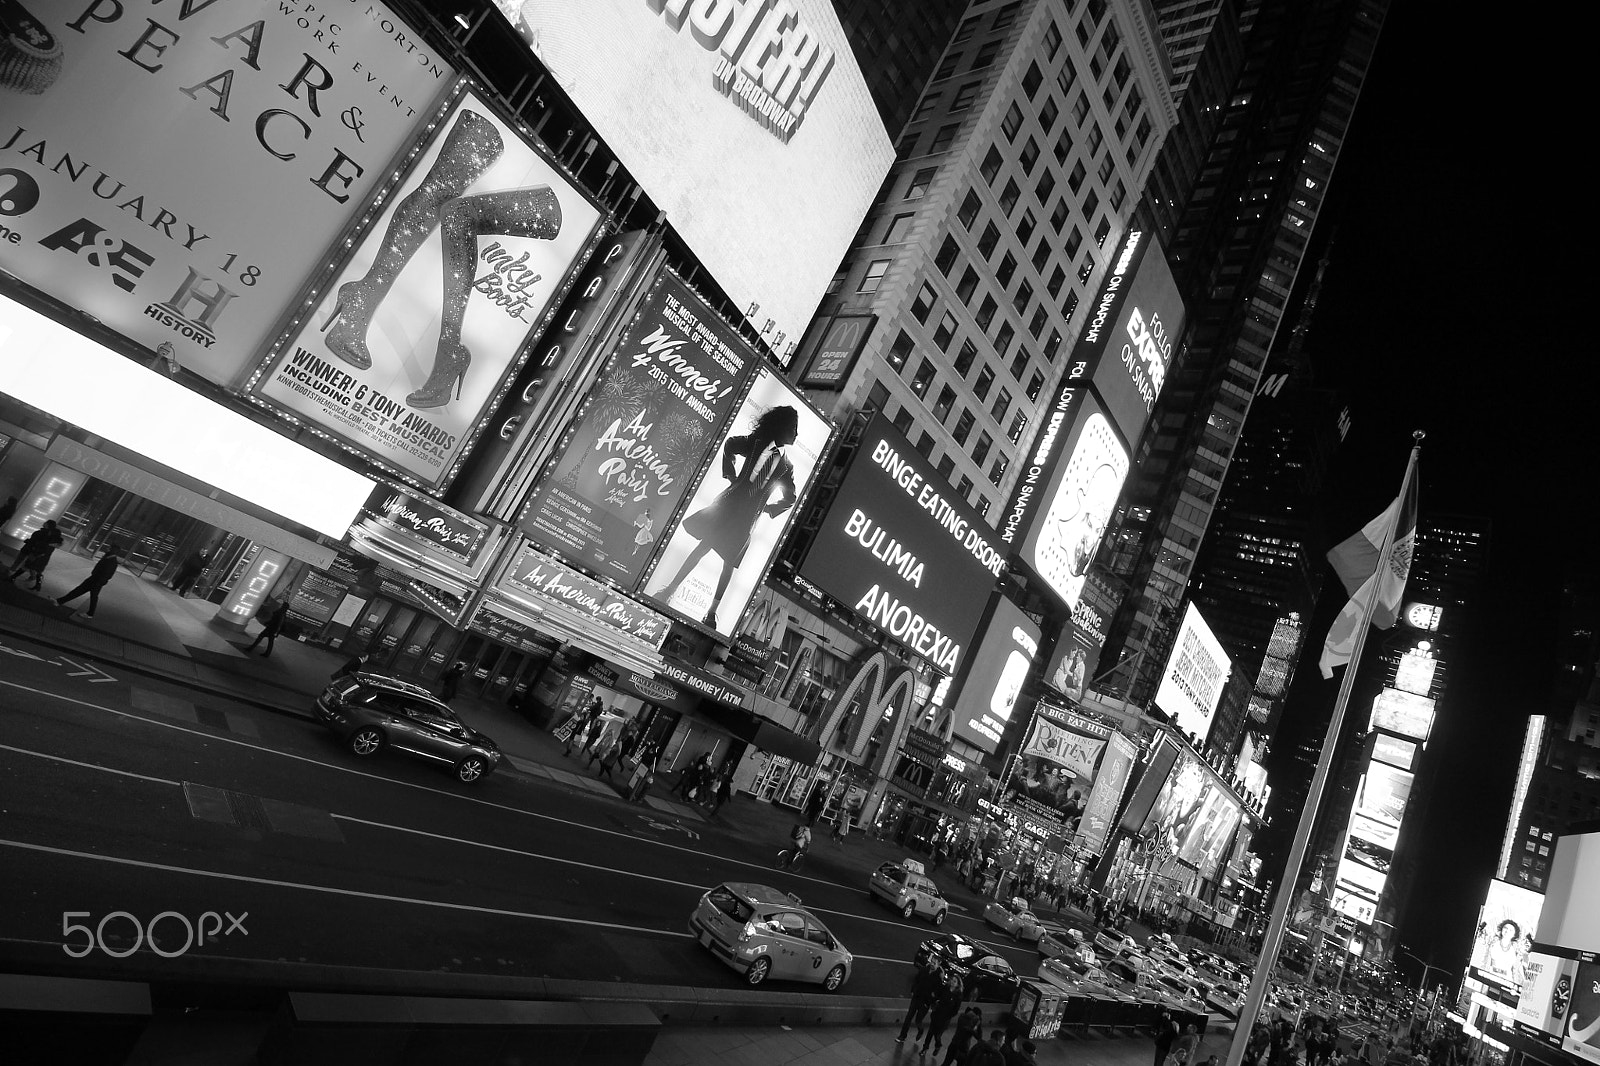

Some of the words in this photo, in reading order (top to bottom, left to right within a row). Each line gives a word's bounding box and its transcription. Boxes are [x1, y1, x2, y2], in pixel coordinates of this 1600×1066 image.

[365, 6, 443, 79] NORTON
[65, 0, 364, 205] PEACE
[352, 61, 416, 119] EVENT
[712, 56, 737, 94] ON
[732, 74, 796, 142] BROADWAY
[340, 106, 365, 143] &
[0, 126, 211, 251] JANUARY
[219, 253, 262, 287] 18
[38, 217, 156, 294] A&E
[1109, 276, 1123, 292] ON
[144, 305, 217, 350] HISTORY
[500, 243, 622, 438] PALACE
[662, 305, 692, 338] MUSICAL
[691, 331, 703, 344] OF
[700, 340, 715, 356] THE
[712, 351, 739, 377] SEASON!
[665, 293, 681, 311] THE
[678, 306, 698, 327] MOST
[695, 322, 745, 370] AWARD-WINNING
[1085, 293, 1116, 344] SNAPCHAT
[640, 323, 733, 405] Winner!
[807, 372, 841, 380] HOURS
[817, 359, 841, 371] 24
[1121, 344, 1137, 374] ON
[276, 374, 362, 425] KINKYBOOTSTHEMUSICAL.COM
[364, 421, 378, 433] FOR
[376, 427, 398, 444] TICKETS
[397, 439, 410, 452] CALL
[283, 363, 351, 407] INCLUDING
[351, 401, 389, 426] BEST
[389, 422, 445, 460] MUSICAL
[292, 346, 358, 394] WINNER!
[354, 384, 369, 400] 6
[367, 390, 406, 421] TONY
[402, 412, 456, 450] AWARDS
[647, 363, 669, 386] 2015
[667, 378, 689, 403] TONY
[686, 397, 716, 423] AWARDS
[623, 408, 653, 442] An
[595, 417, 674, 496] American
[598, 457, 649, 502] Paris
[1026, 466, 1042, 484] ON
[871, 438, 923, 497] BINGE
[917, 483, 968, 541] EATING
[1001, 485, 1034, 544] SNAPCHAT
[843, 508, 926, 589] BULIMIA
[523, 564, 548, 587] An
[542, 572, 601, 616] American
[605, 602, 633, 630] Paris
[1073, 598, 1103, 628] SPRING
[736, 639, 769, 661] McDonald's
[855, 583, 961, 674] ANOREXIA
[588, 667, 615, 687] EXCHANGE
[687, 674, 721, 697] MONEY
[721, 691, 743, 706] ATM
[1067, 715, 1086, 729] FAT
